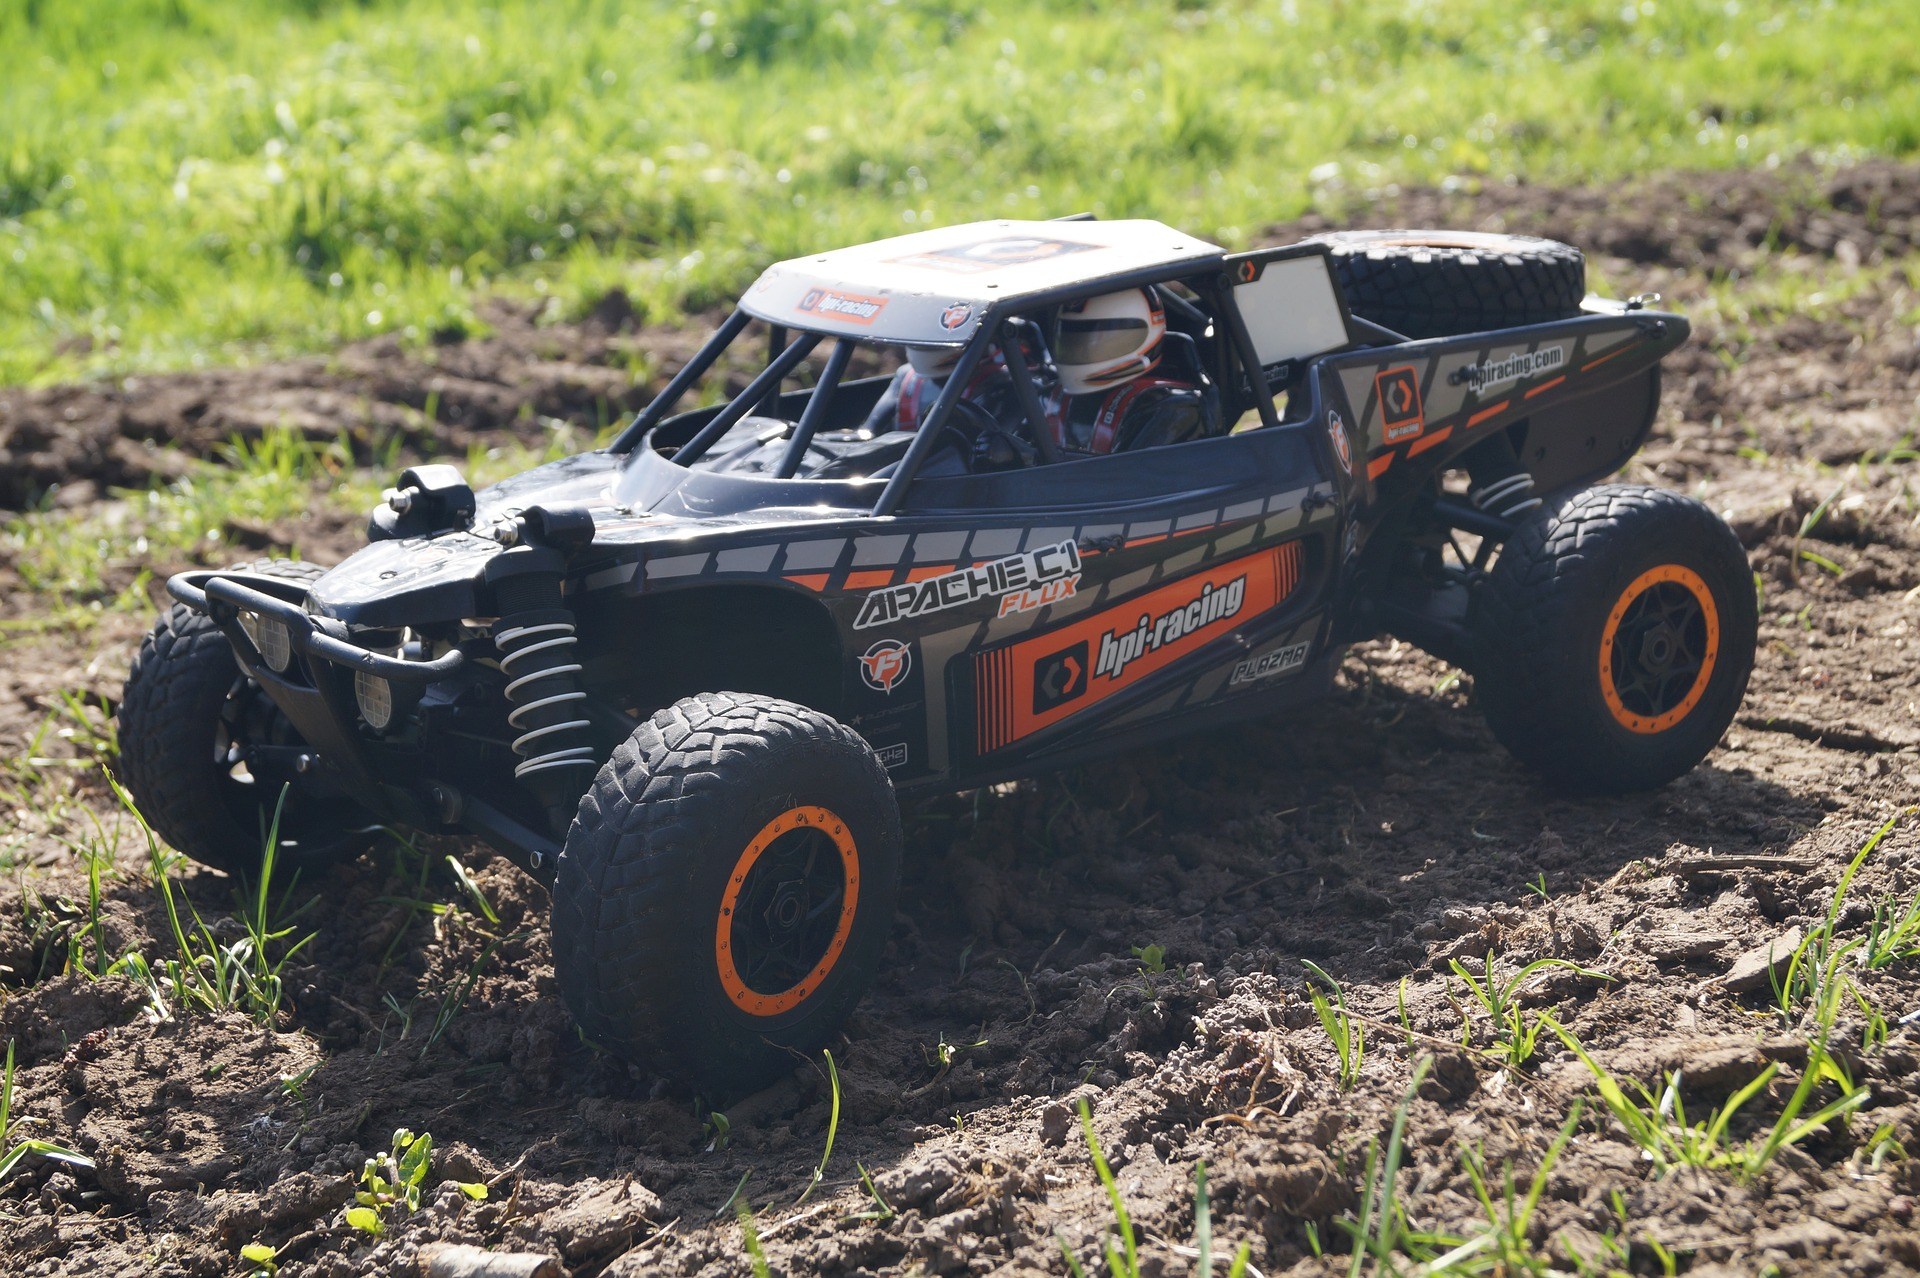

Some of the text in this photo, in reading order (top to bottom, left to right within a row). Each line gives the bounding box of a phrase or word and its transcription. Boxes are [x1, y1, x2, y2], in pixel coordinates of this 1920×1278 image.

[1470, 346, 1562, 393] hpiracing.com
[854, 540, 1081, 628] APACHE C1
[998, 574, 1081, 618] FLUX
[1095, 576, 1246, 679] hpi-racing
[1231, 641, 1309, 684] PLAZMA
[877, 748, 904, 762] GHz
